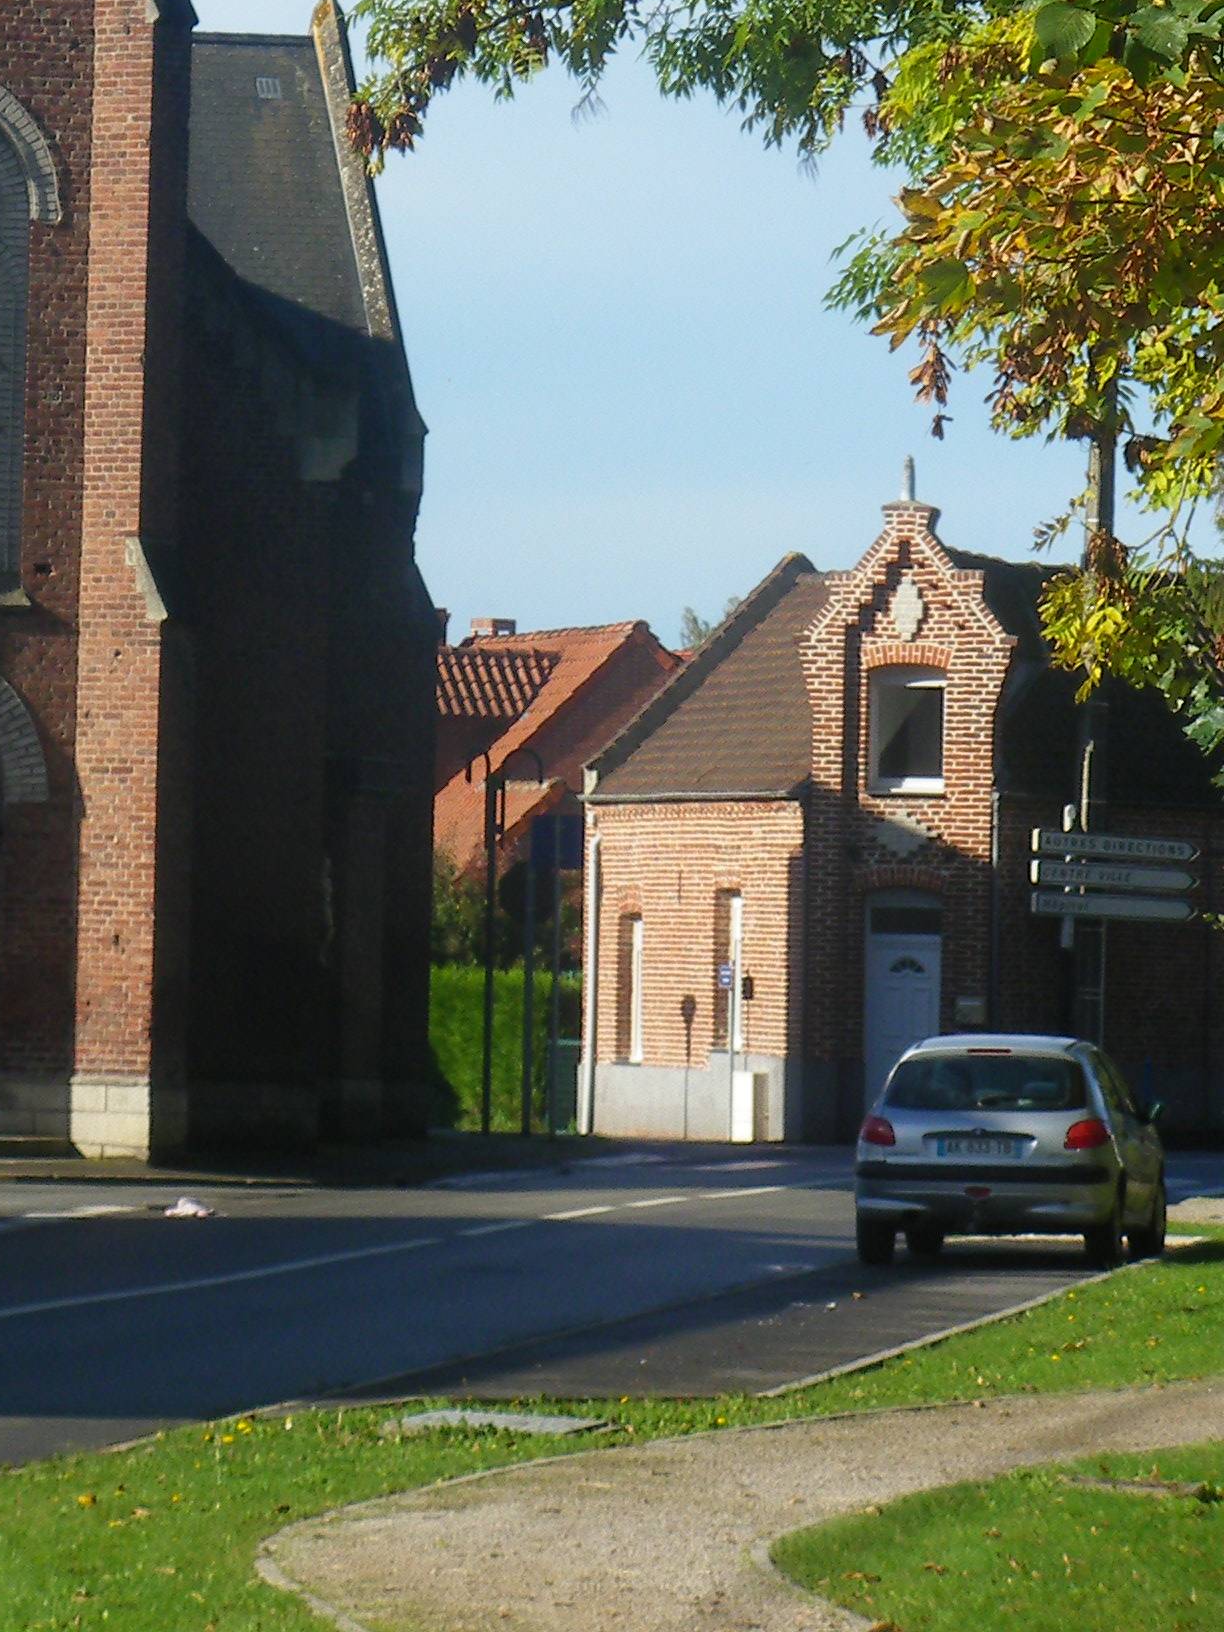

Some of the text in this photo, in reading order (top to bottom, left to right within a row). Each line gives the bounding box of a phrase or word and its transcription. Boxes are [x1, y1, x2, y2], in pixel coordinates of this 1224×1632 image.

[1045, 835, 1185, 856] AUTRES DIRECTIONS
[1042, 866, 1131, 882] CENTRE VILLE
